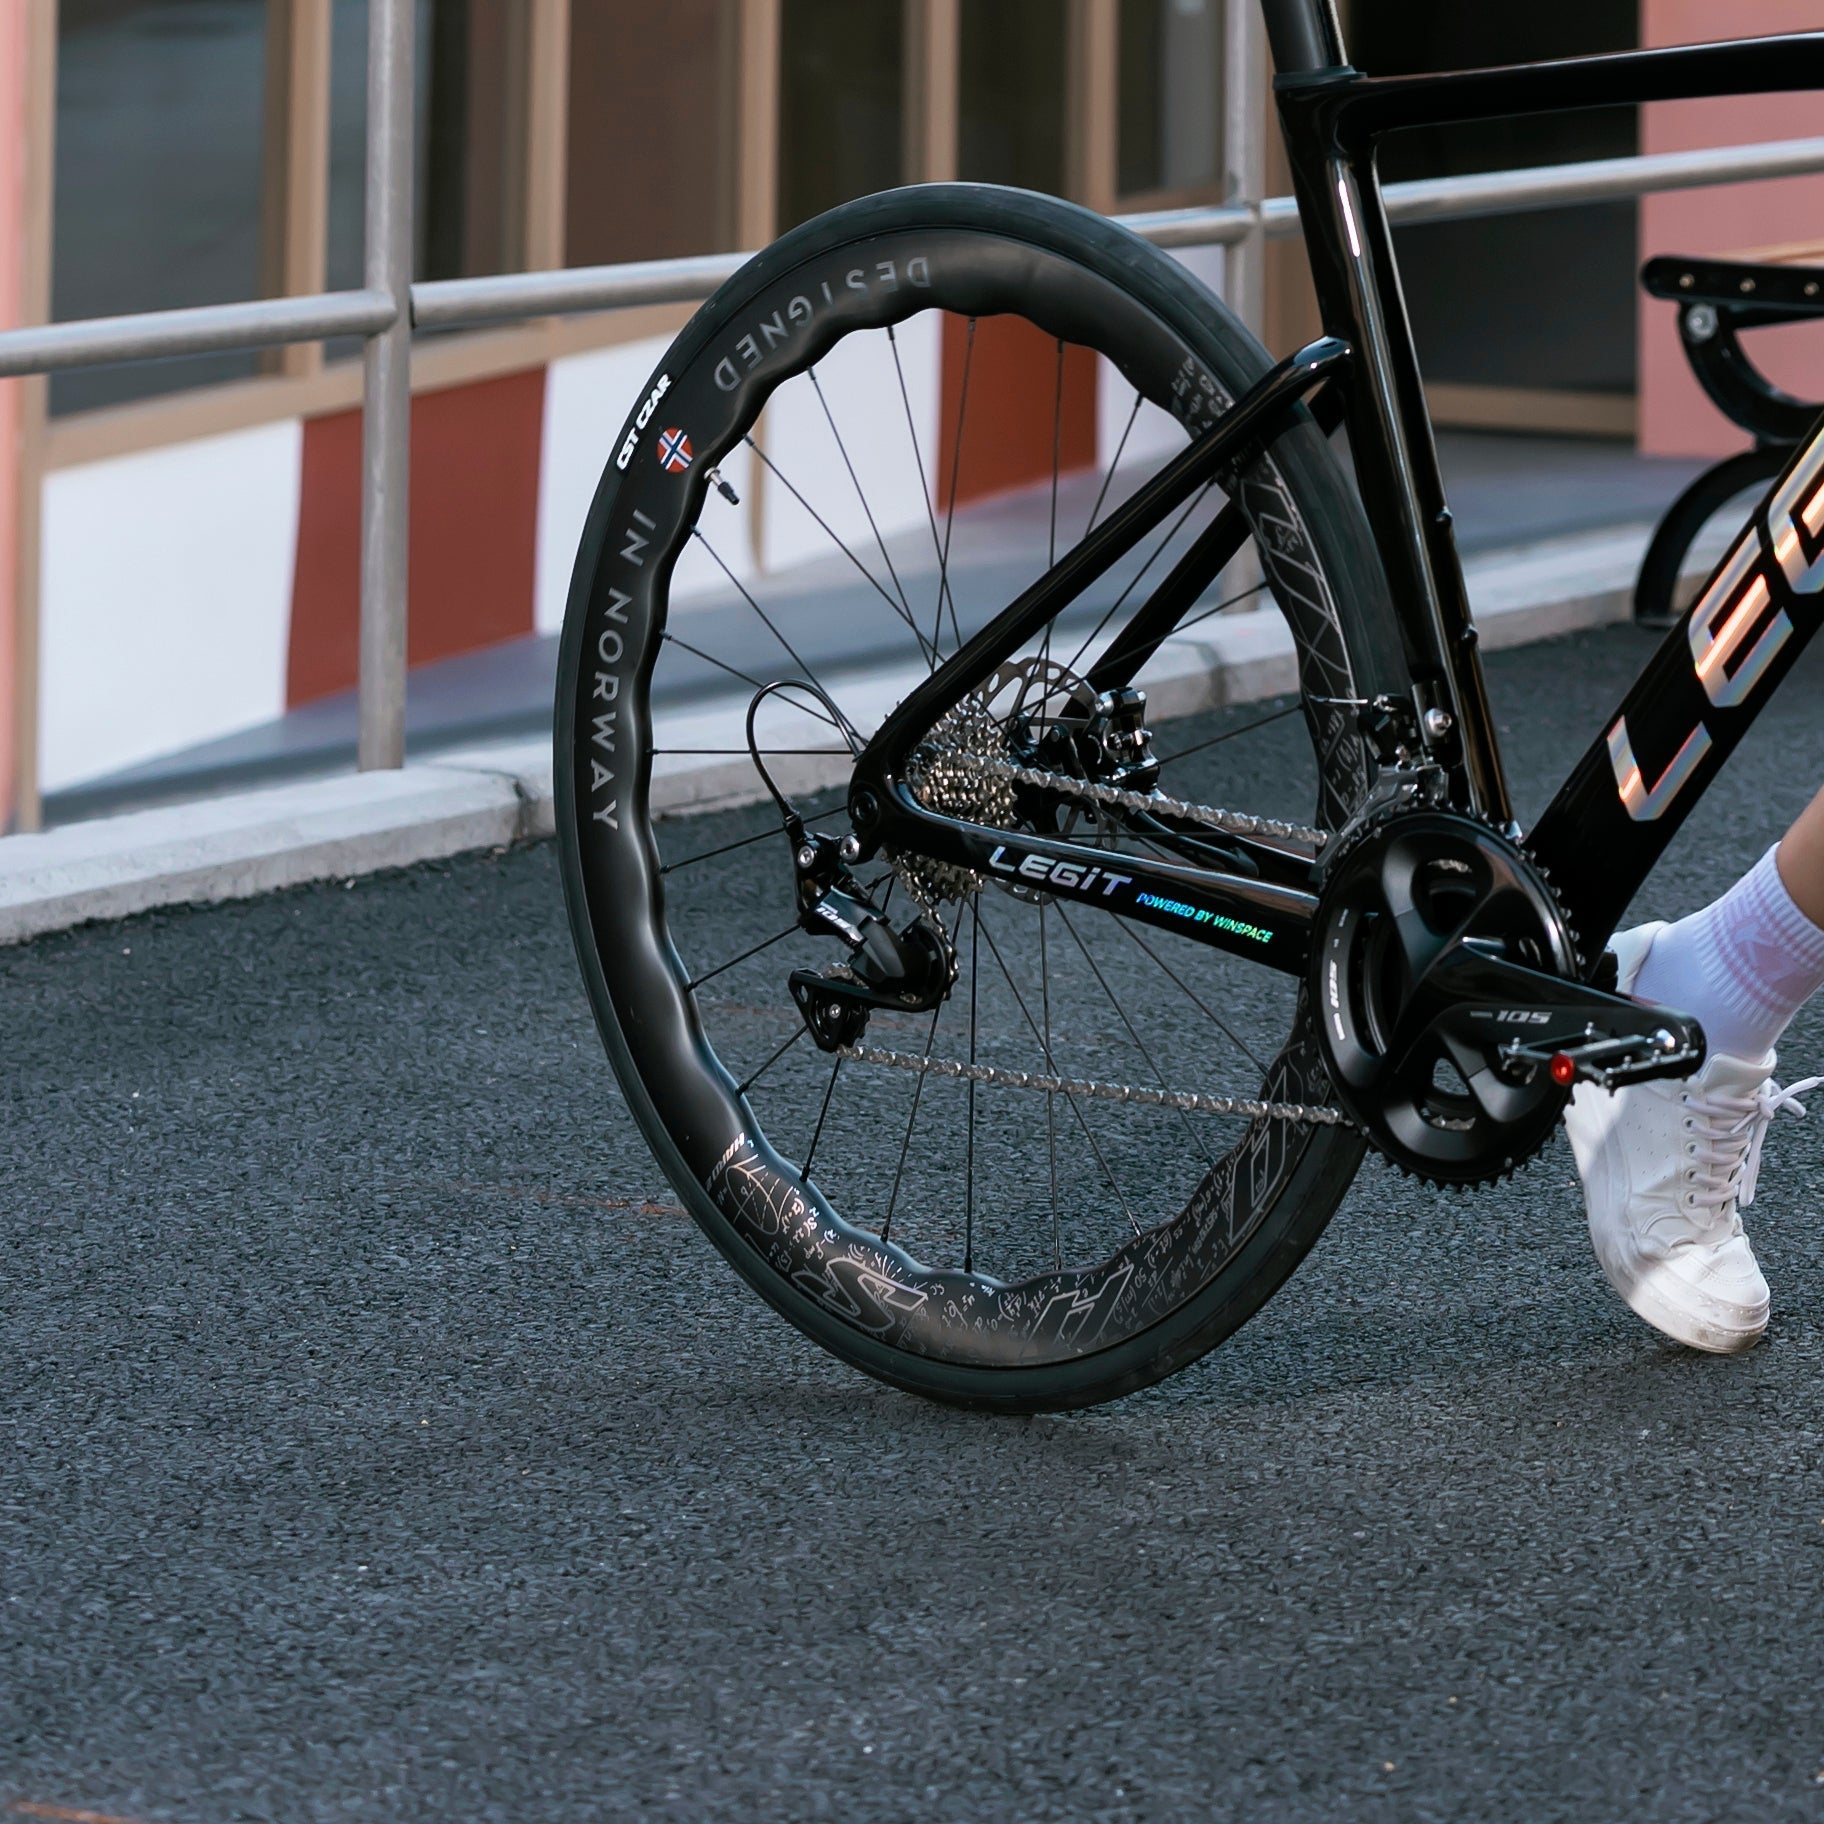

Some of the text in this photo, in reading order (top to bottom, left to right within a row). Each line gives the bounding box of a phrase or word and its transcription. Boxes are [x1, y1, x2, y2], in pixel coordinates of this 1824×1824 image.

[616, 373, 672, 471] CST CZAR
[590, 255, 932, 832] DESIGNED IN NORWAY
[1135, 892, 1196, 919] POWERED
[1195, 908, 1214, 924] BY
[1213, 914, 1274, 944] WINSPACE
[1496, 1009, 1552, 1024] 105
